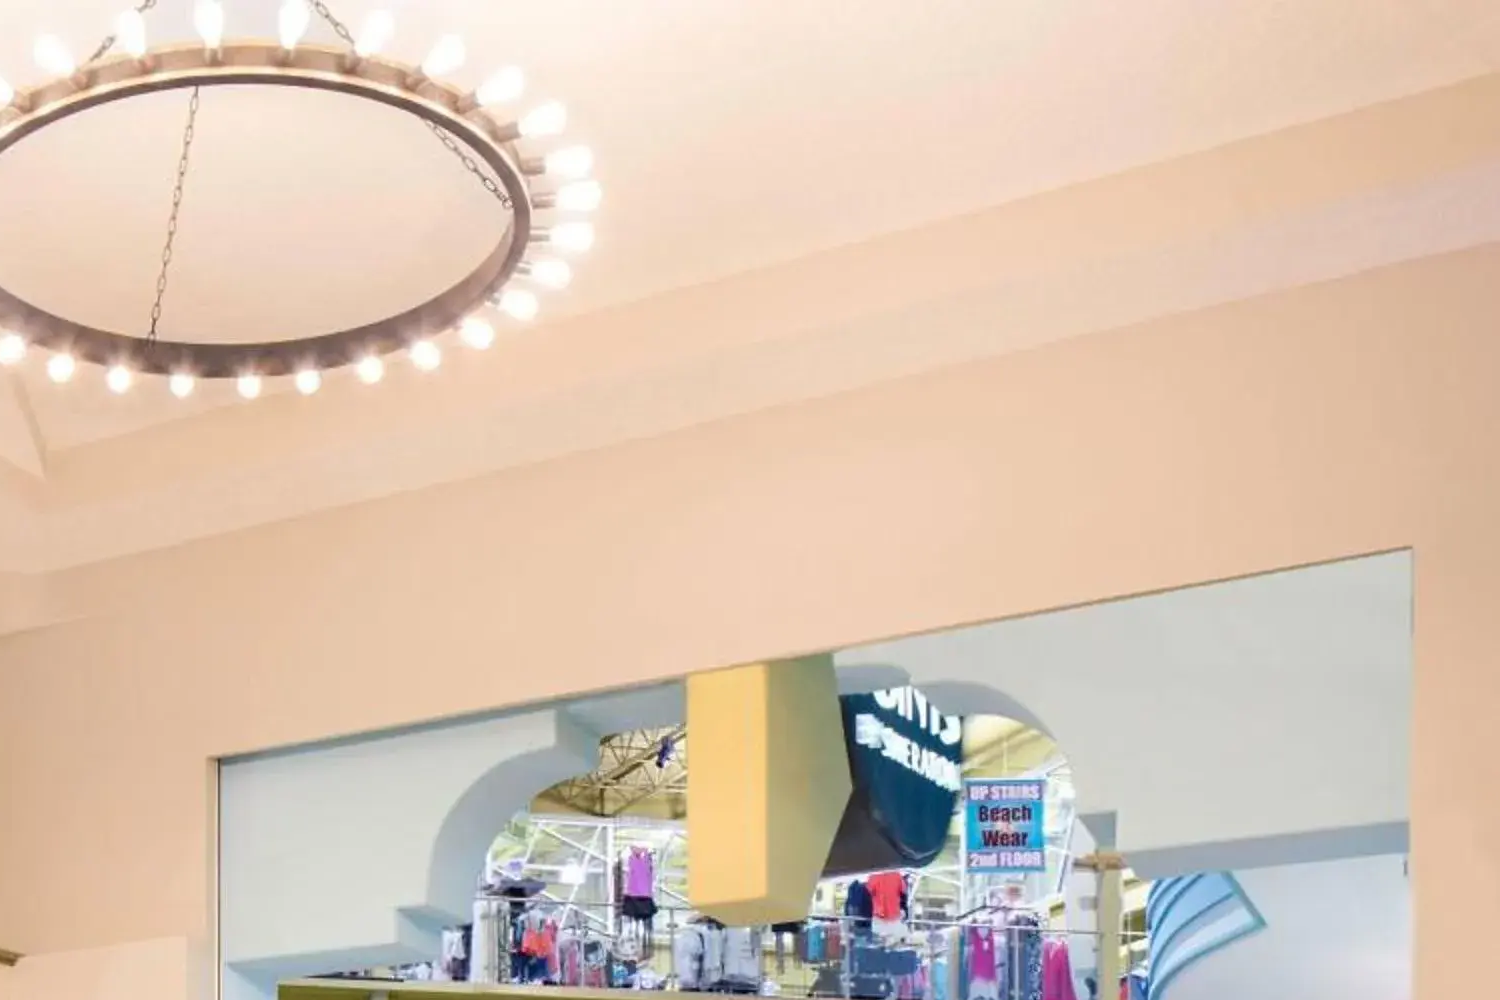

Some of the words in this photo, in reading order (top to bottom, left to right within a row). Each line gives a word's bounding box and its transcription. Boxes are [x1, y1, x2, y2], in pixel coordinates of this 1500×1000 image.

[970, 785, 989, 800] UP
[991, 785, 1039, 799] STAIRS
[978, 804, 1032, 823] Beach
[982, 829, 1029, 847] Wear
[970, 853, 997, 867] 2nd
[1000, 851, 1041, 866] FLOOR
